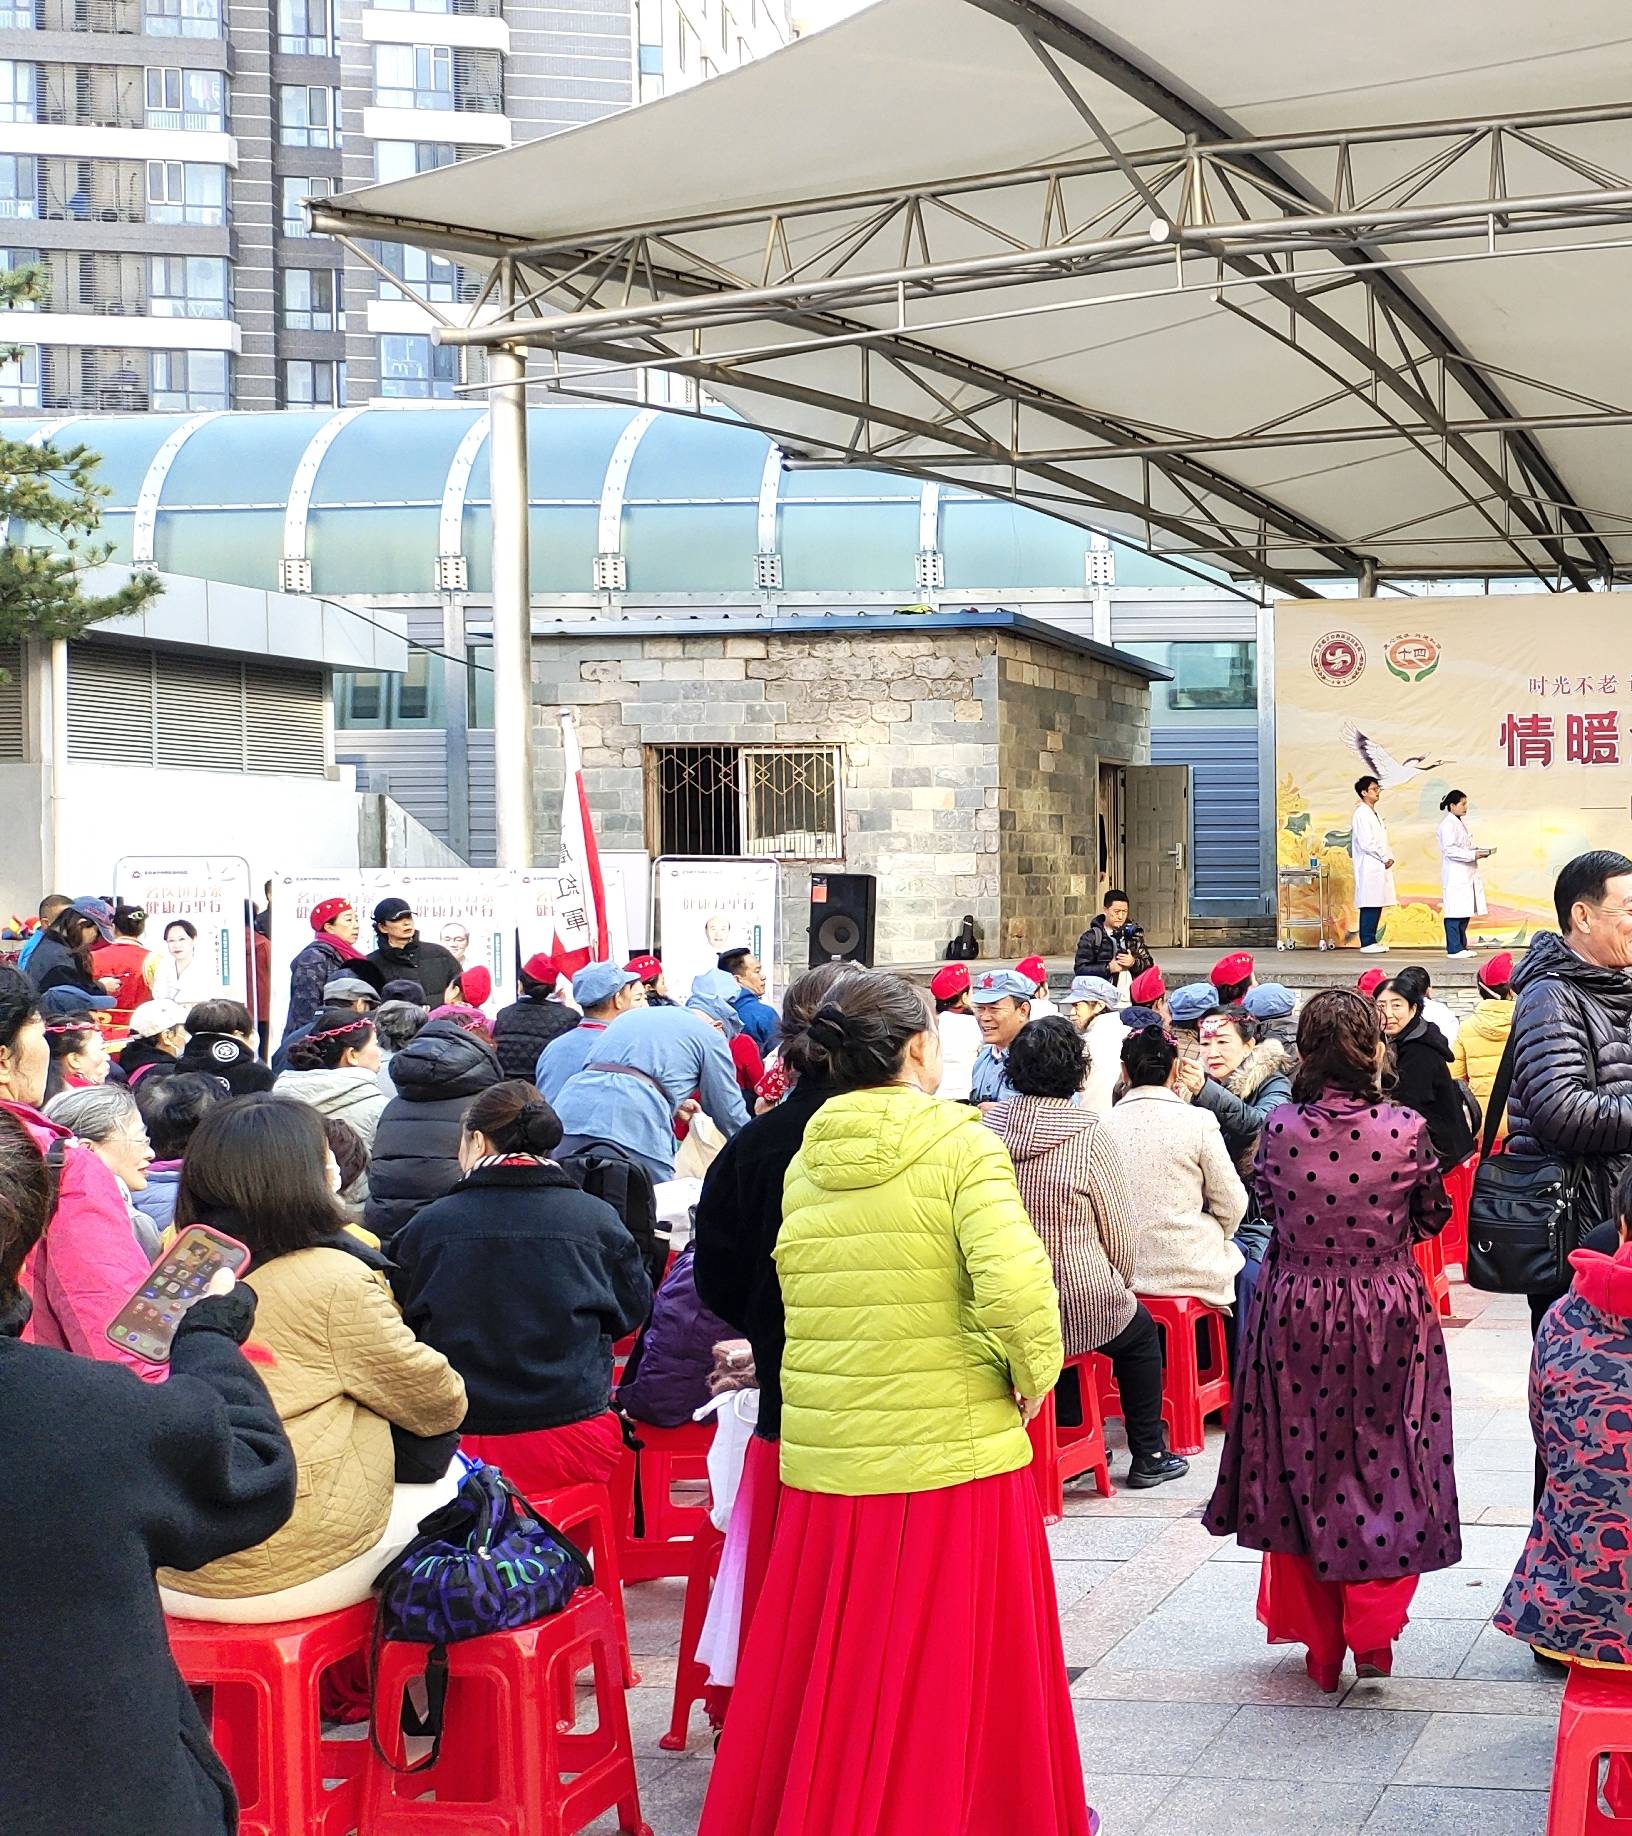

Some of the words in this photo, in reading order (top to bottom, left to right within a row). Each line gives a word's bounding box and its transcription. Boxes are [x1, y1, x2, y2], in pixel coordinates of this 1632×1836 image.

[1397, 648, 1427, 660] 十四
[1528, 675, 1619, 697] 时光不老
